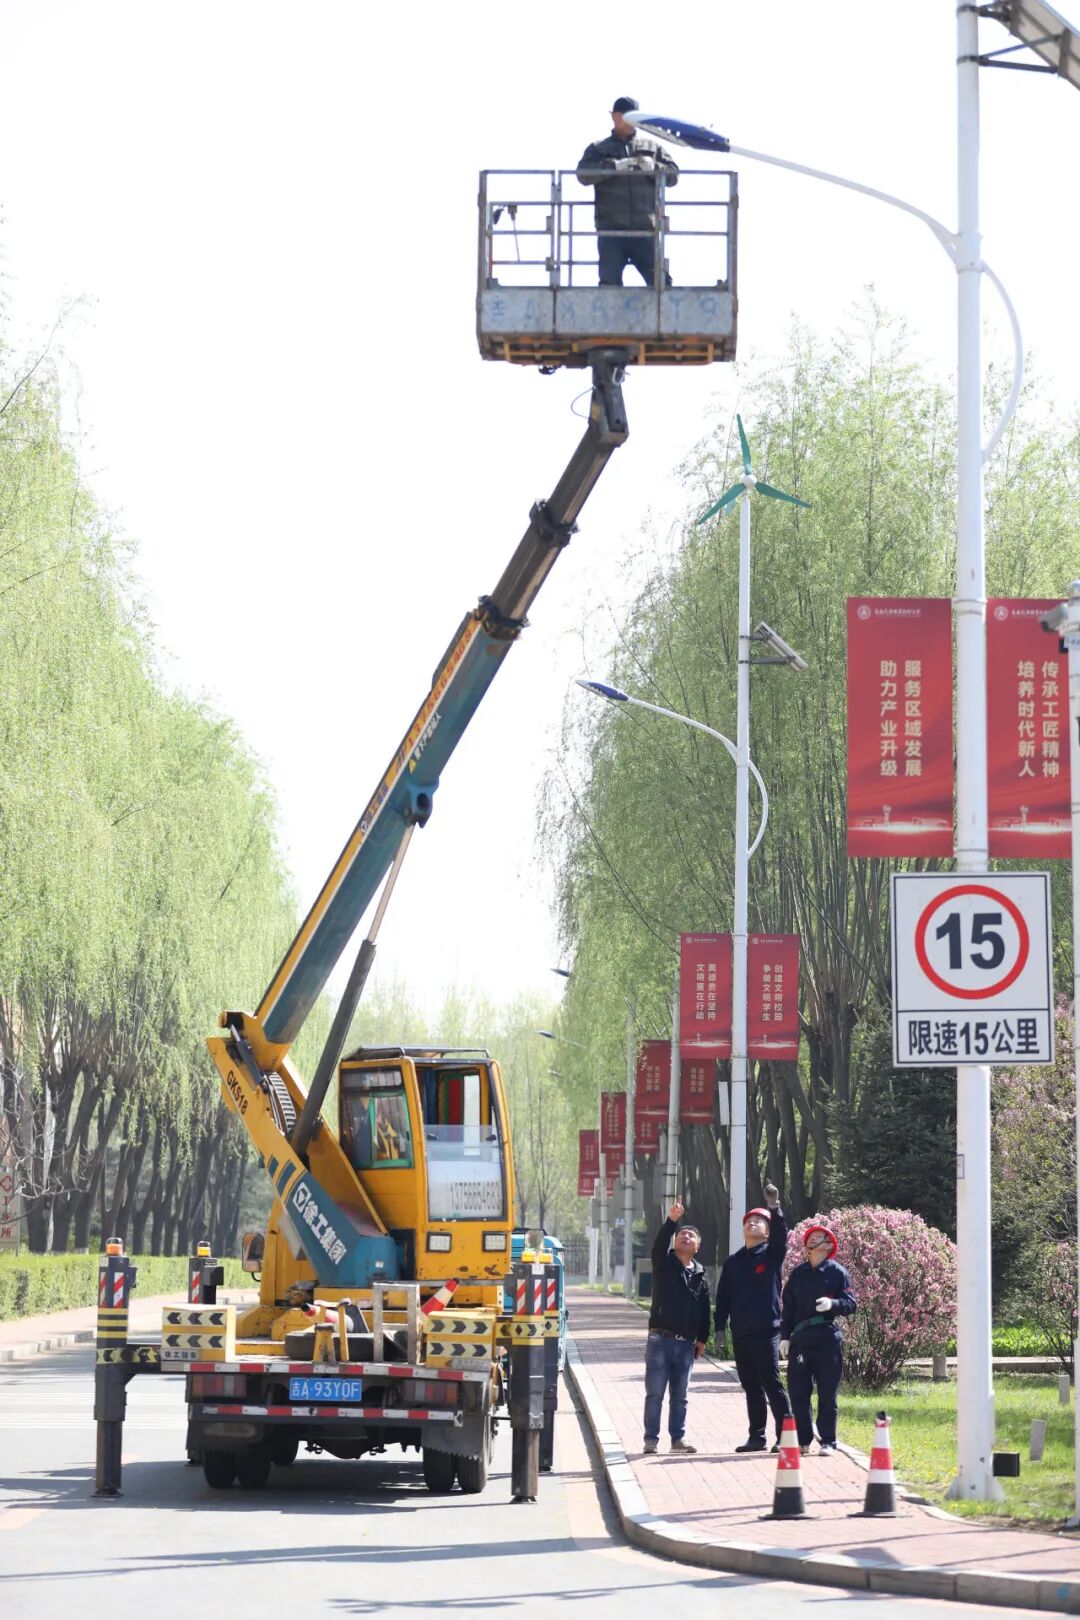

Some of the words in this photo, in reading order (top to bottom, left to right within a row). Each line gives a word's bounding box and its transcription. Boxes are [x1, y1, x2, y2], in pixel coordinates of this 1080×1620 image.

[880, 660, 898, 777] 助力产业升级
[904, 660, 922, 777] 服务区域发展
[1017, 660, 1035, 777] 培养时代新人
[1042, 661, 1059, 778] 传承工匠精神
[936, 912, 1005, 970] 15
[696, 963, 705, 1020] 文明重在行动
[762, 964, 771, 1021] 争做文明学生
[774, 964, 783, 1021] 创建文明校园
[908, 1018, 1040, 1056] 限速15公里
[226, 1069, 248, 1115] GKS18
[302, 1200, 347, 1265] 徐工集团
